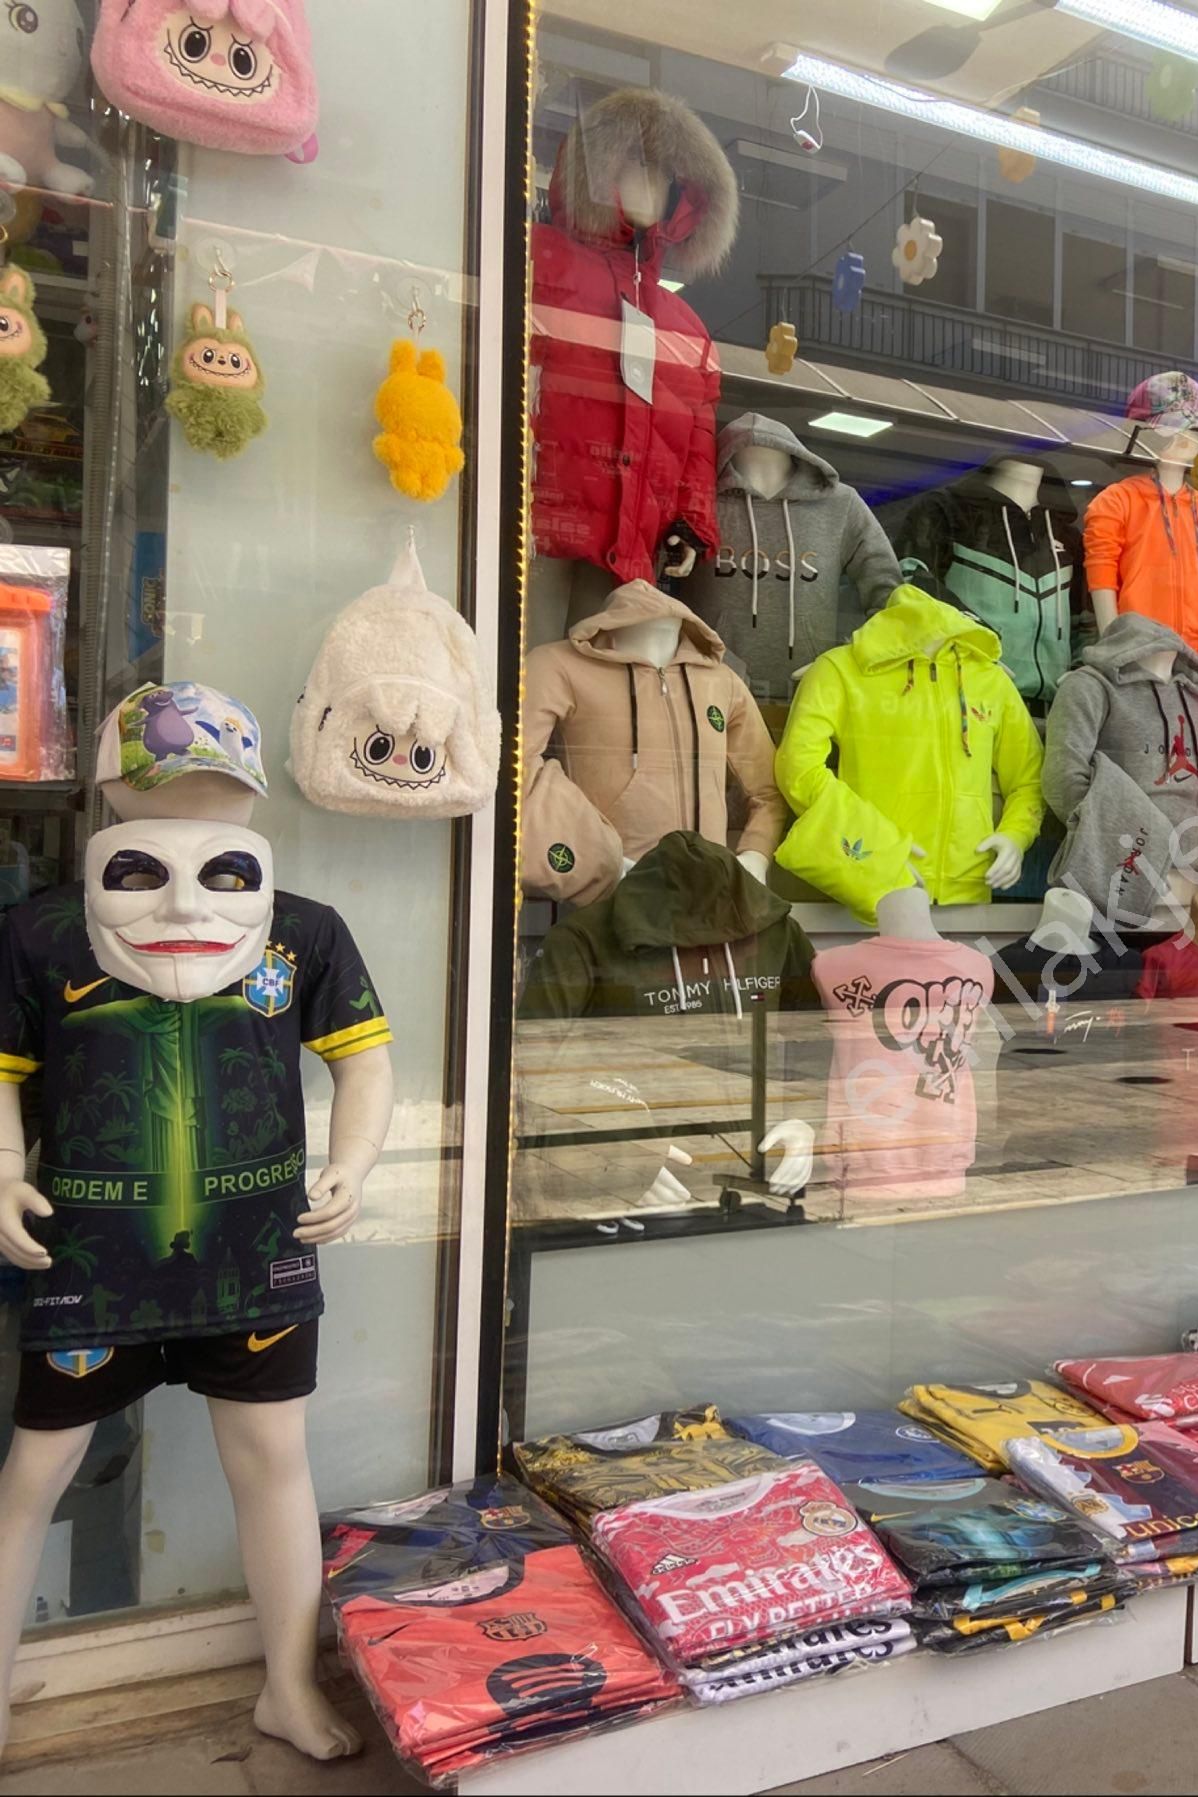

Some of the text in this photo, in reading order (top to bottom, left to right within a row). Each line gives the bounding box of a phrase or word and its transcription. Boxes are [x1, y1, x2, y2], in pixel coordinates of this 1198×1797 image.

[714, 545, 819, 582] BOSS
[723, 976, 781, 991] HLFIGER
[52, 1179, 123, 1201] ORDEM
[133, 1180, 148, 1201] E
[657, 1542, 884, 1626] Emirates
